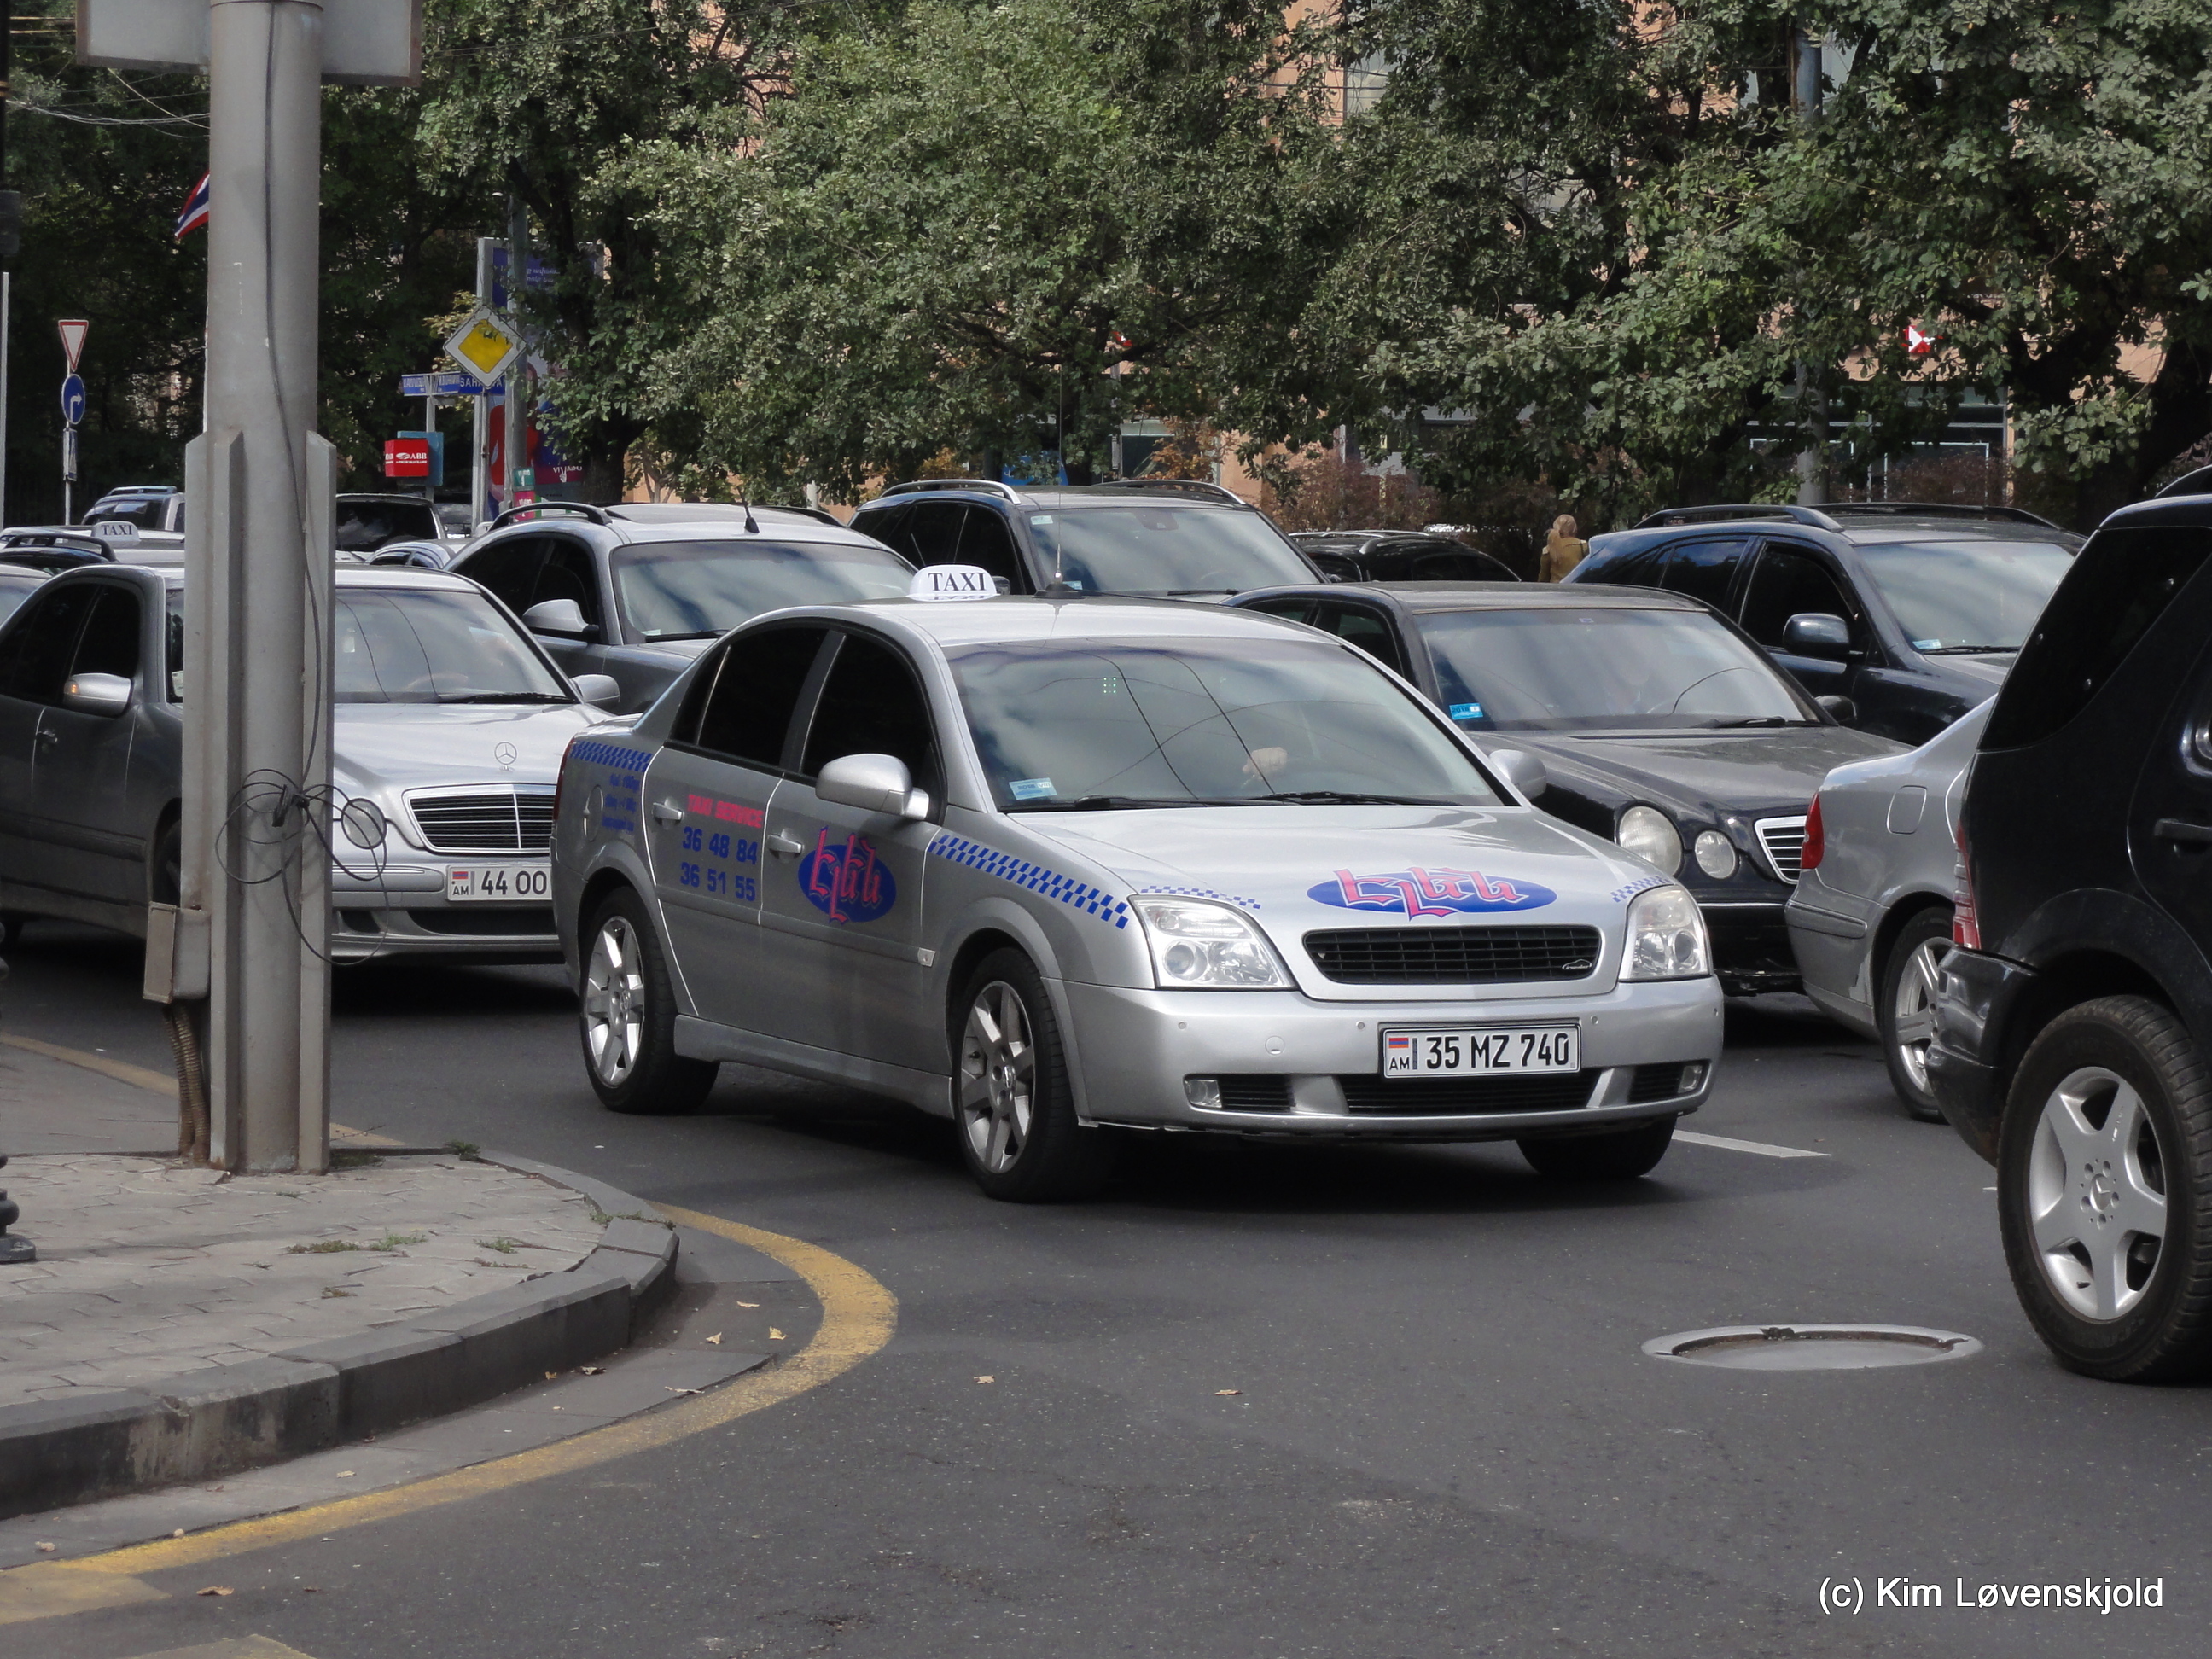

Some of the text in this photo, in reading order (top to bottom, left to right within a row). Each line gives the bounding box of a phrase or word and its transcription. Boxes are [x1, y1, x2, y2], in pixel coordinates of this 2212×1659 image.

[101, 524, 133, 536] TAXI
[928, 572, 987, 591] TAXI
[688, 794, 764, 829] TAXI SERVICE
[683, 826, 758, 865] 36 48 84
[452, 885, 469, 896] AM
[481, 870, 508, 895] 44
[680, 862, 756, 902] 36 51 55
[1426, 1033, 1569, 1069] 35 MZ 740
[1388, 1057, 1410, 1071] AM
